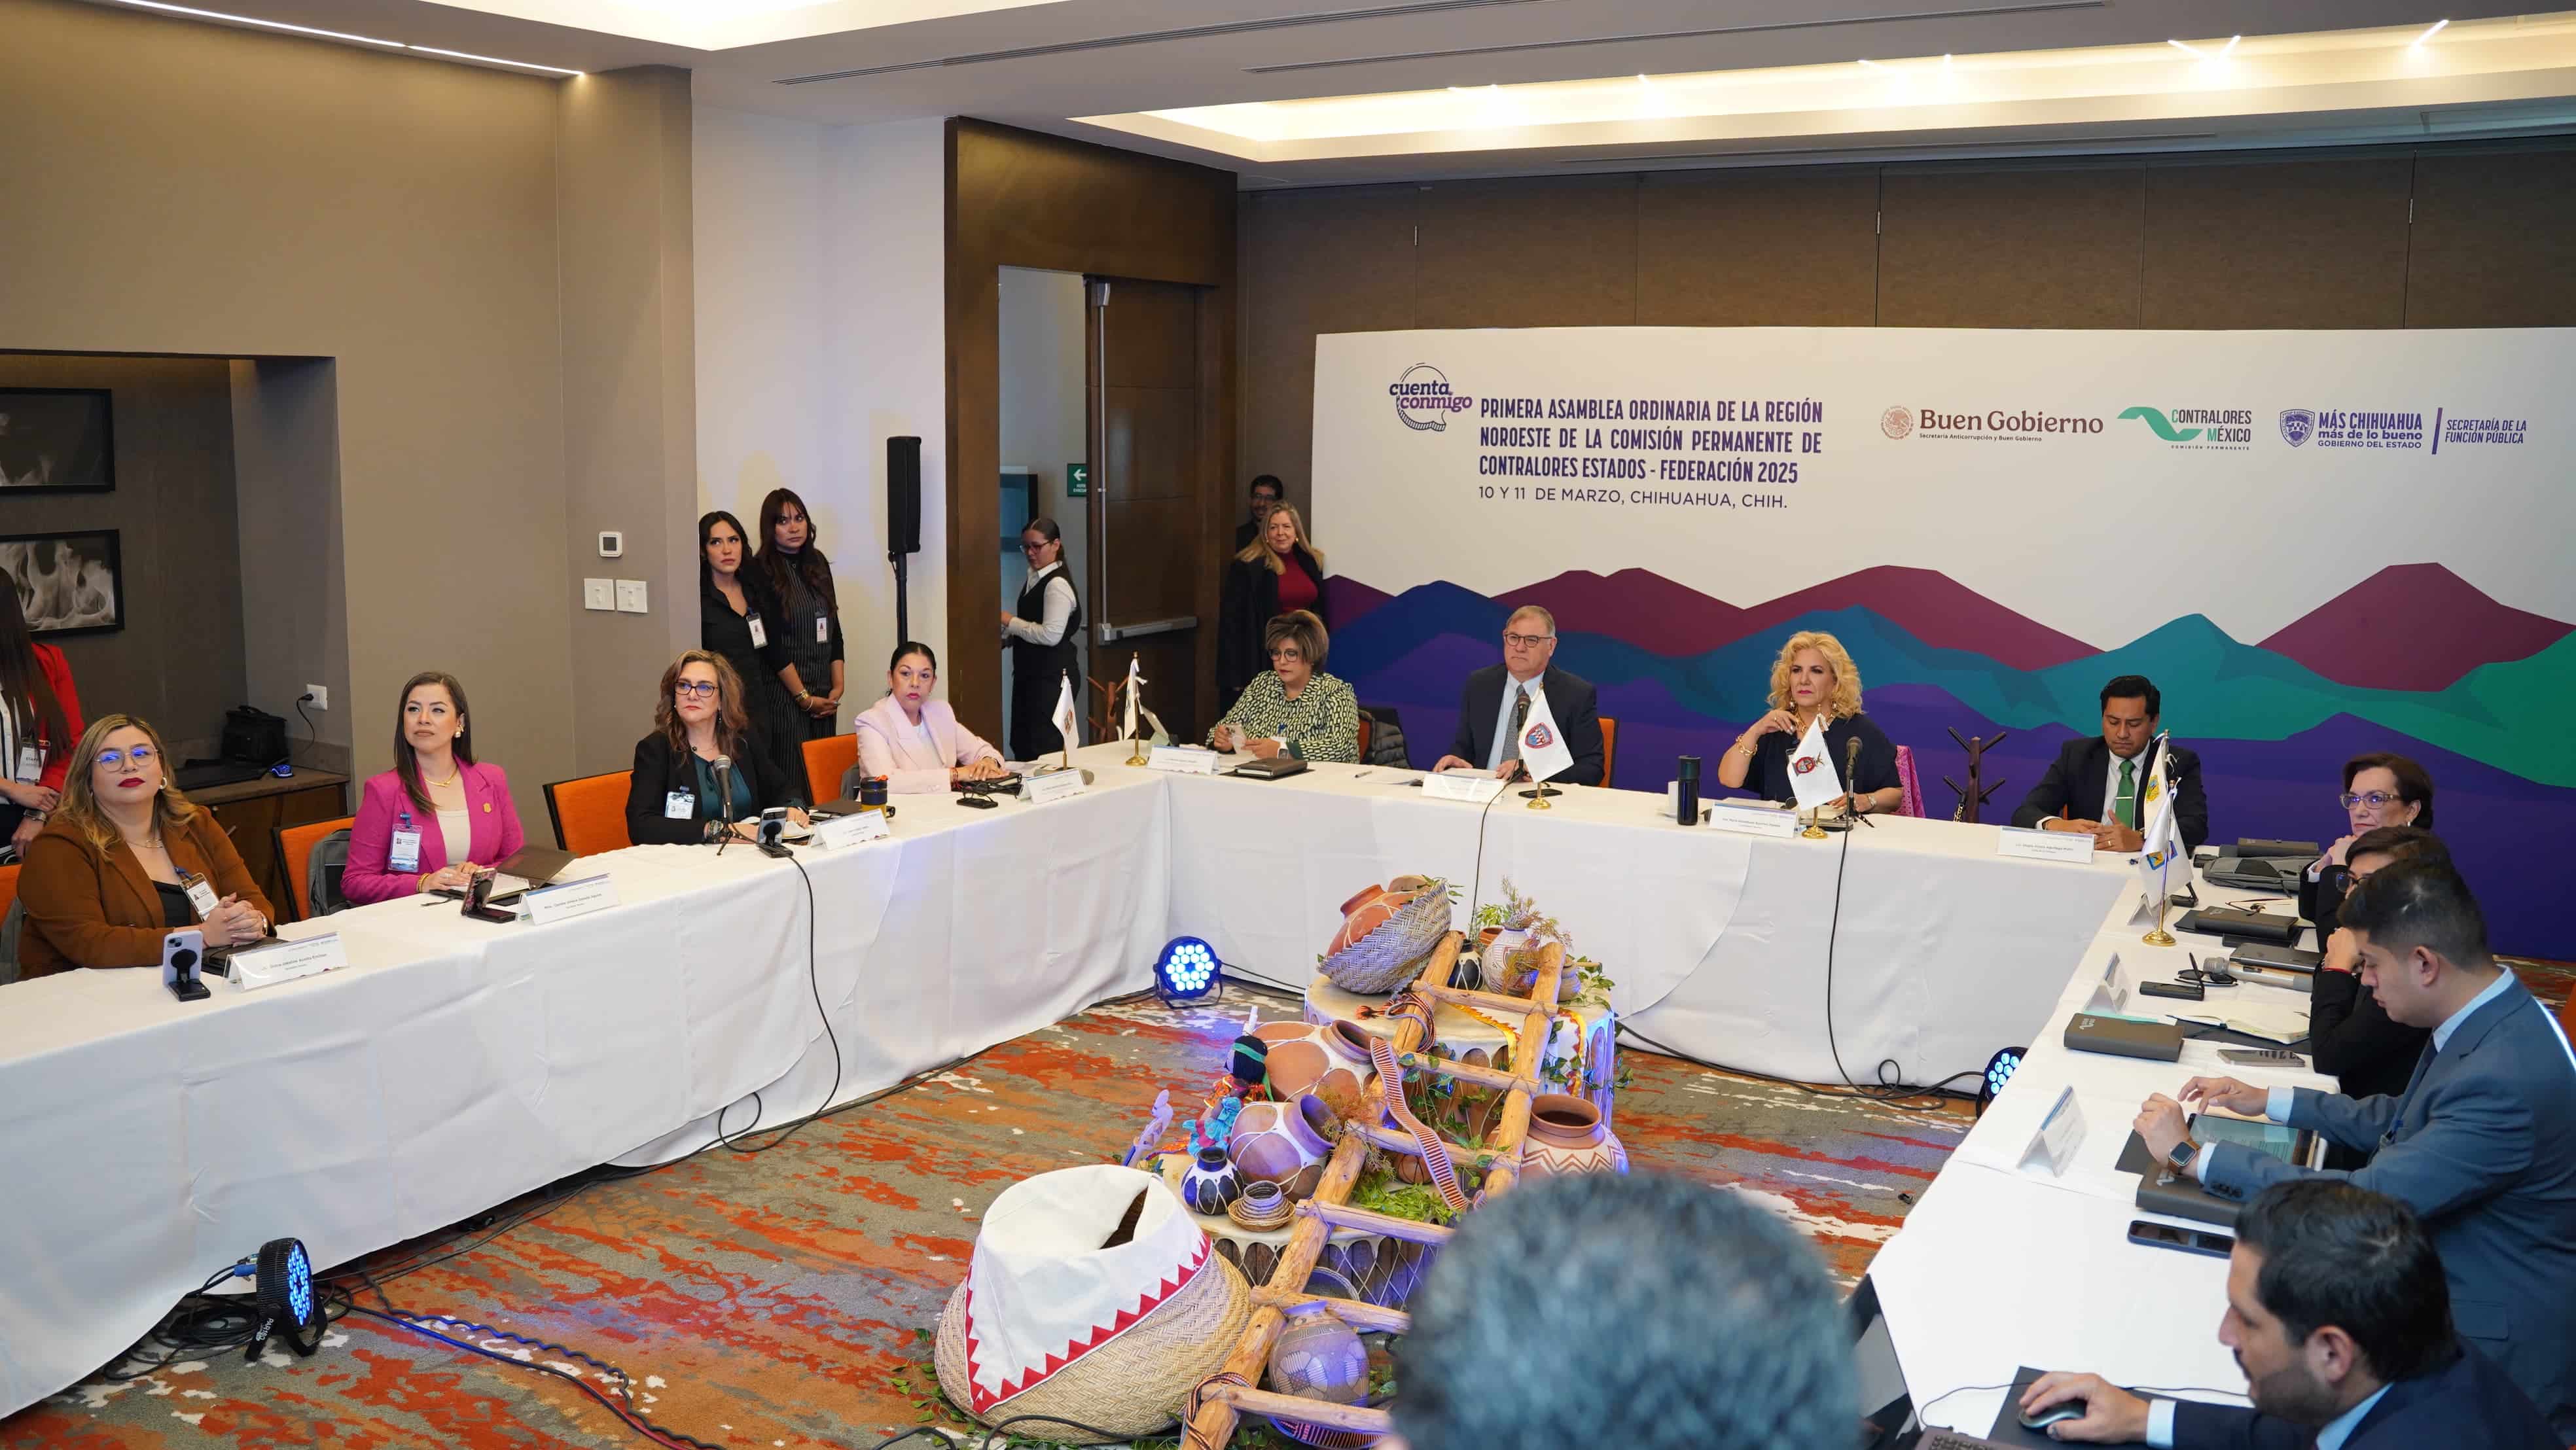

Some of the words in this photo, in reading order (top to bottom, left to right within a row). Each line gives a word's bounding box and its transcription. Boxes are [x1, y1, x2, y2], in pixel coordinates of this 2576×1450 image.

[1389, 380, 1450, 396] cuenta
[1400, 391, 1473, 413] conmigo
[1480, 398, 1544, 419] PRIMERA
[1548, 398, 1624, 420] ASAMBLEA
[1628, 399, 1711, 421] ORDINARIA
[1716, 400, 1736, 421] DE
[1741, 400, 1760, 422] LA
[1765, 397, 1823, 423] REGIÓN
[1920, 409, 1982, 431] Buen
[1987, 410, 2104, 434] Gobierno
[2171, 409, 2252, 425] CONTRALORES
[2318, 409, 2346, 429] MÁS
[2350, 412, 2423, 430] CHIHUAHUA
[2446, 417, 2500, 432] SECRETARÍA
[2502, 419, 2514, 431] DE
[2515, 419, 2527, 431] LA
[1480, 427, 1551, 448] NOROESTE
[1559, 428, 1577, 448] DE
[1585, 429, 1603, 449] LA
[1610, 425, 1683, 450] COMISIÓN
[1692, 430, 1793, 453] PERMANENTE
[1802, 432, 1823, 453] DE
[1949, 433, 1993, 442] Anticorrupción
[2207, 425, 2251, 442] MÉXICO
[2318, 429, 2344, 439] más
[2347, 430, 2363, 439] de
[2367, 430, 2378, 440] lo
[2382, 430, 2423, 440] bueno
[2445, 430, 2484, 443] FUNCIÓN
[2485, 430, 2524, 444] PÚBLICA
[1479, 455, 1578, 477] CONTRALORES
[1582, 457, 1647, 480] ESTADOS
[1660, 457, 1754, 482] FEDERACIÓN
[1757, 461, 1798, 484] 2025
[1478, 486, 1494, 499] 10
[1499, 486, 1509, 500] Y
[1514, 487, 1526, 500] 11
[1535, 487, 1556, 501] DE
[1561, 488, 1625, 505] MARZO,
[1630, 490, 1736, 510] CHIHUAHUA,
[1742, 493, 1788, 508] CHIH.
